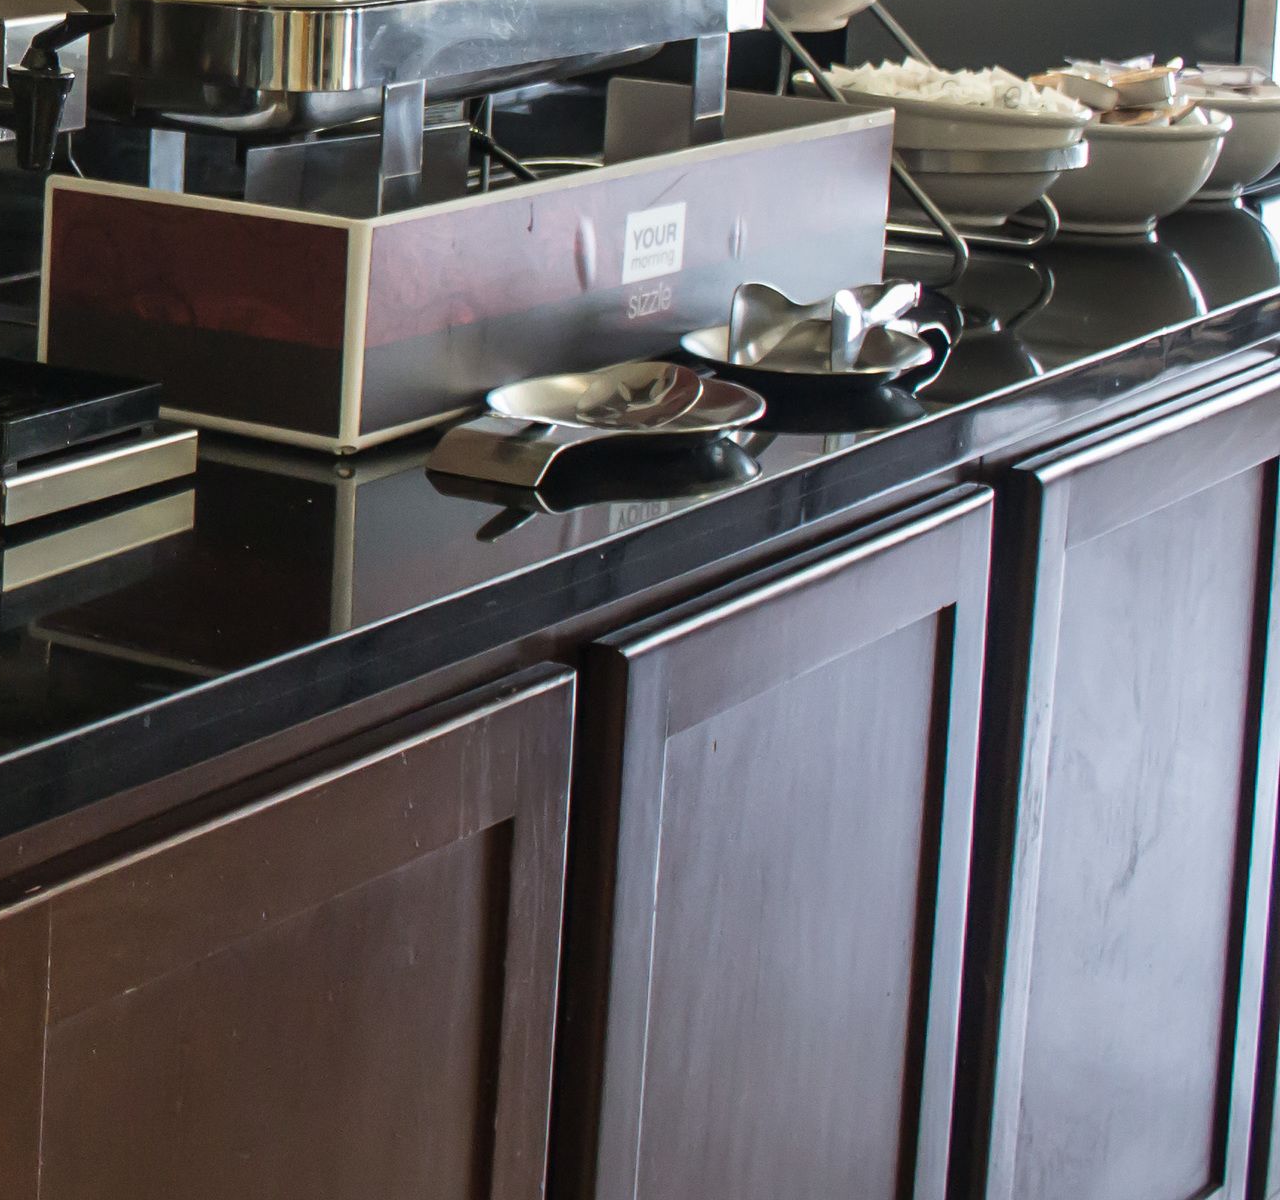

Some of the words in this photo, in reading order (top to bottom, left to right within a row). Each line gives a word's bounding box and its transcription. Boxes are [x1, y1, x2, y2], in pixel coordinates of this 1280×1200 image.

[633, 222, 677, 251] YOUR
[630, 250, 674, 272] morning
[627, 283, 673, 320] sizzle
